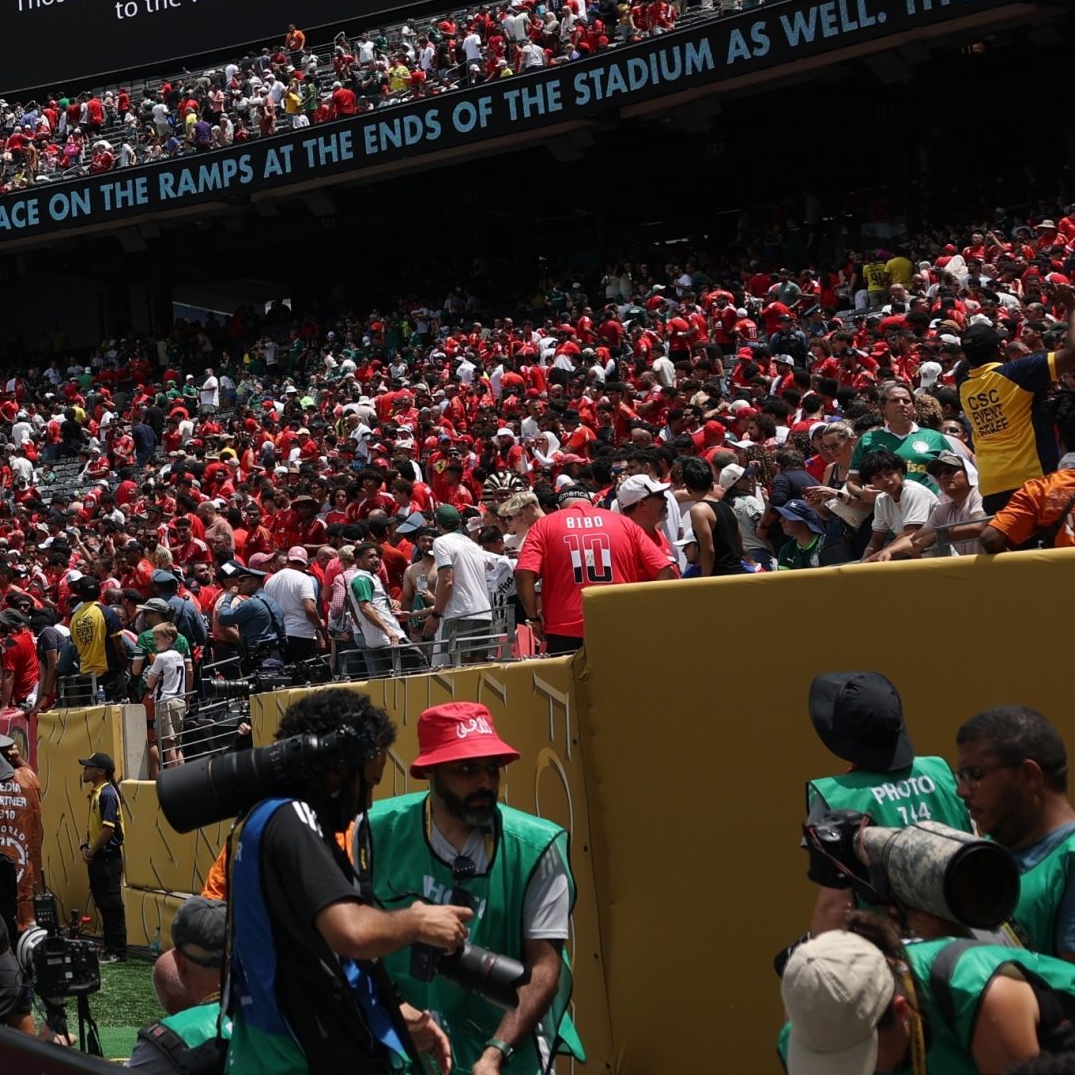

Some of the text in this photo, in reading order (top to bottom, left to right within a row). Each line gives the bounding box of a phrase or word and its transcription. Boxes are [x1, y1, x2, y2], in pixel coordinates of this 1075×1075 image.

[114, 1, 138, 20] to
[48, 188, 91, 221] ON
[99, 176, 149, 210] THE
[158, 154, 254, 199] RAMPS
[263, 144, 294, 178] AT
[303, 130, 354, 166] THE
[364, 108, 442, 154] ENDS
[452, 96, 493, 133] OF
[504, 80, 563, 120] THE
[573, 38, 715, 106] STADIUM
[726, 21, 771, 64] AS
[967, 388, 1000, 411] CSC
[972, 403, 1004, 426] EVENT
[565, 515, 604, 529] BIBO
[563, 532, 614, 584] 10
[871, 774, 936, 805] PHOTO
